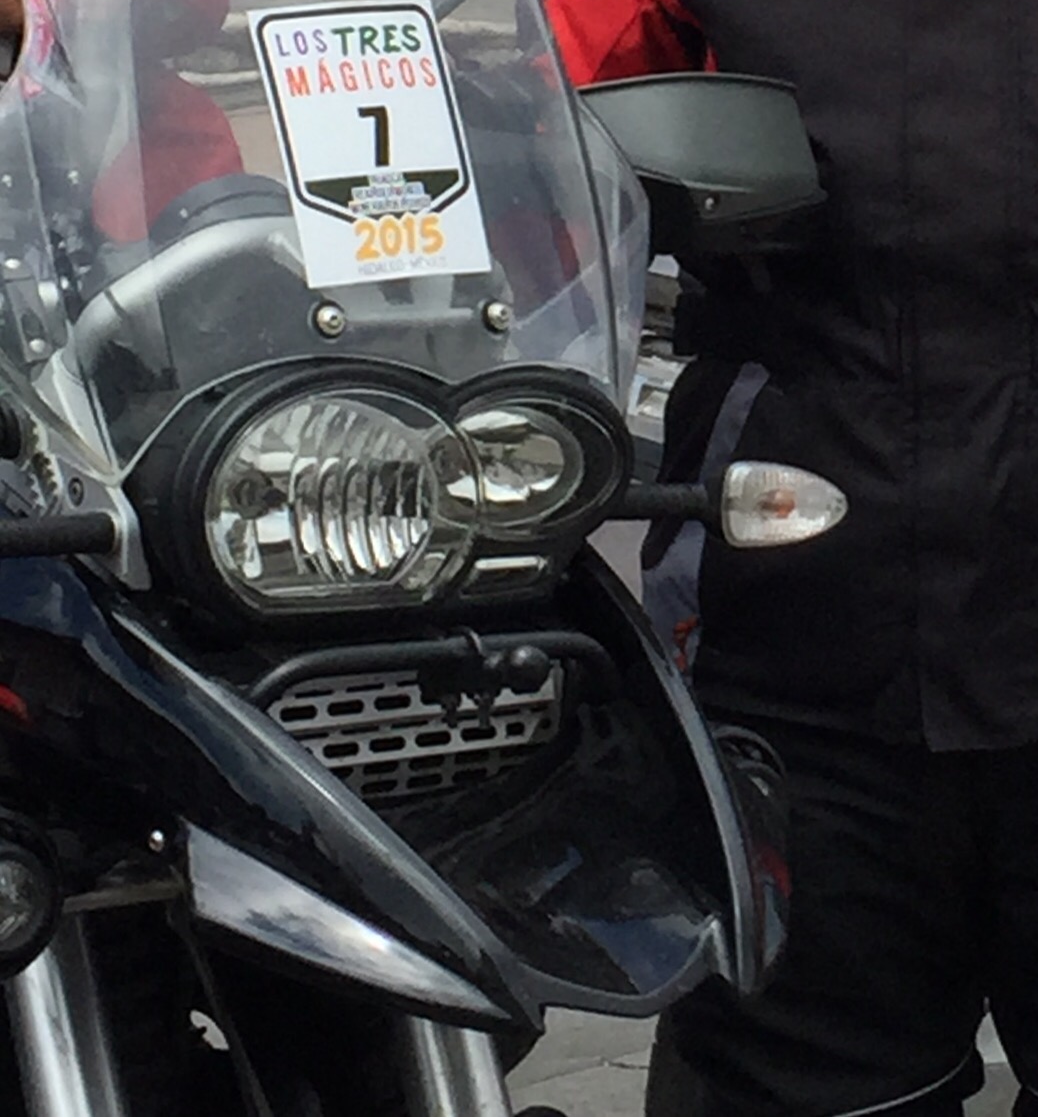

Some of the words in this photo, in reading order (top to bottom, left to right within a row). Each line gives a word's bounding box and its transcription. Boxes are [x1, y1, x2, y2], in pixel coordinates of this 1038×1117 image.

[275, 28, 328, 57] LOS
[331, 24, 421, 56] TRES
[284, 56, 437, 98] MÁGICOS
[354, 215, 445, 261] 2015
